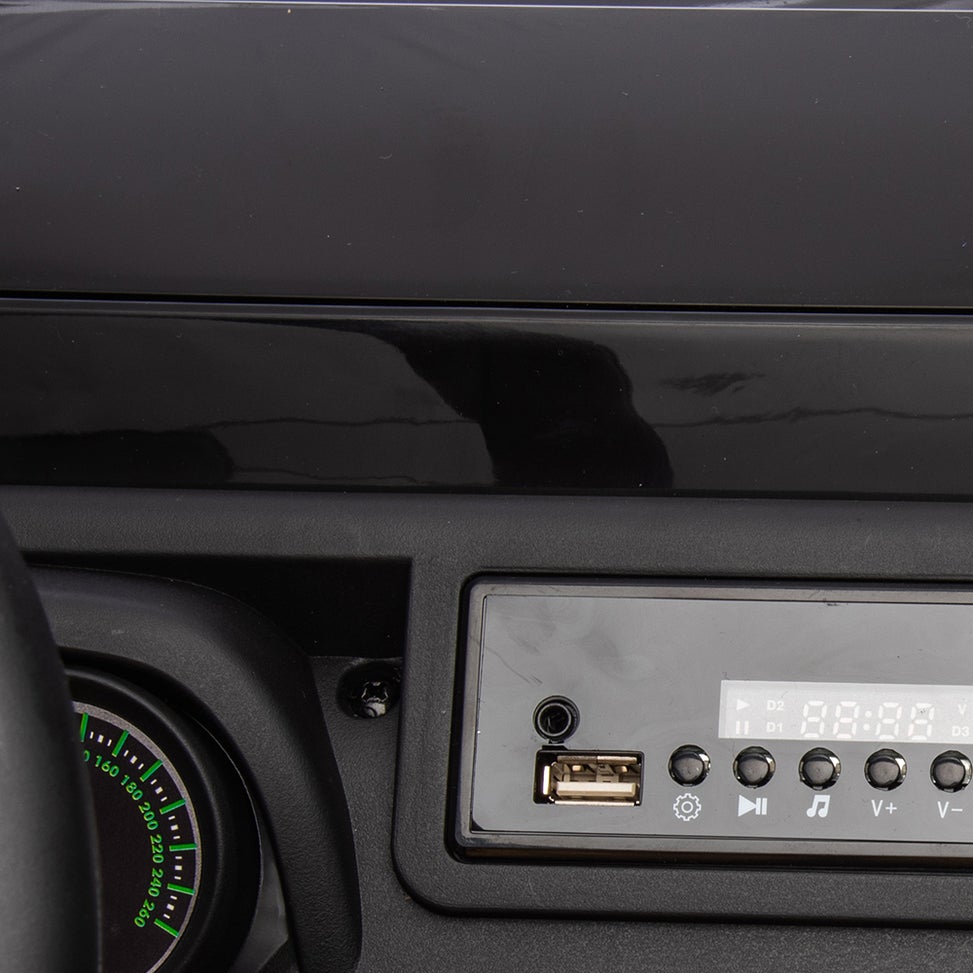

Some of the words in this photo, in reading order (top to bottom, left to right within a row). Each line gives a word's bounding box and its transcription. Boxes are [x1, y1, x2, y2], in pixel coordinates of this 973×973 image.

[767, 700, 785, 711] D2
[766, 721, 784, 733] D1
[951, 726, 971, 737] D3
[95, 755, 120, 778] 160
[121, 775, 144, 801] 180
[139, 802, 159, 831] 200
[871, 799, 898, 816] V+
[150, 834, 164, 864] 220
[148, 868, 164, 897] 240
[134, 899, 156, 928] 260
